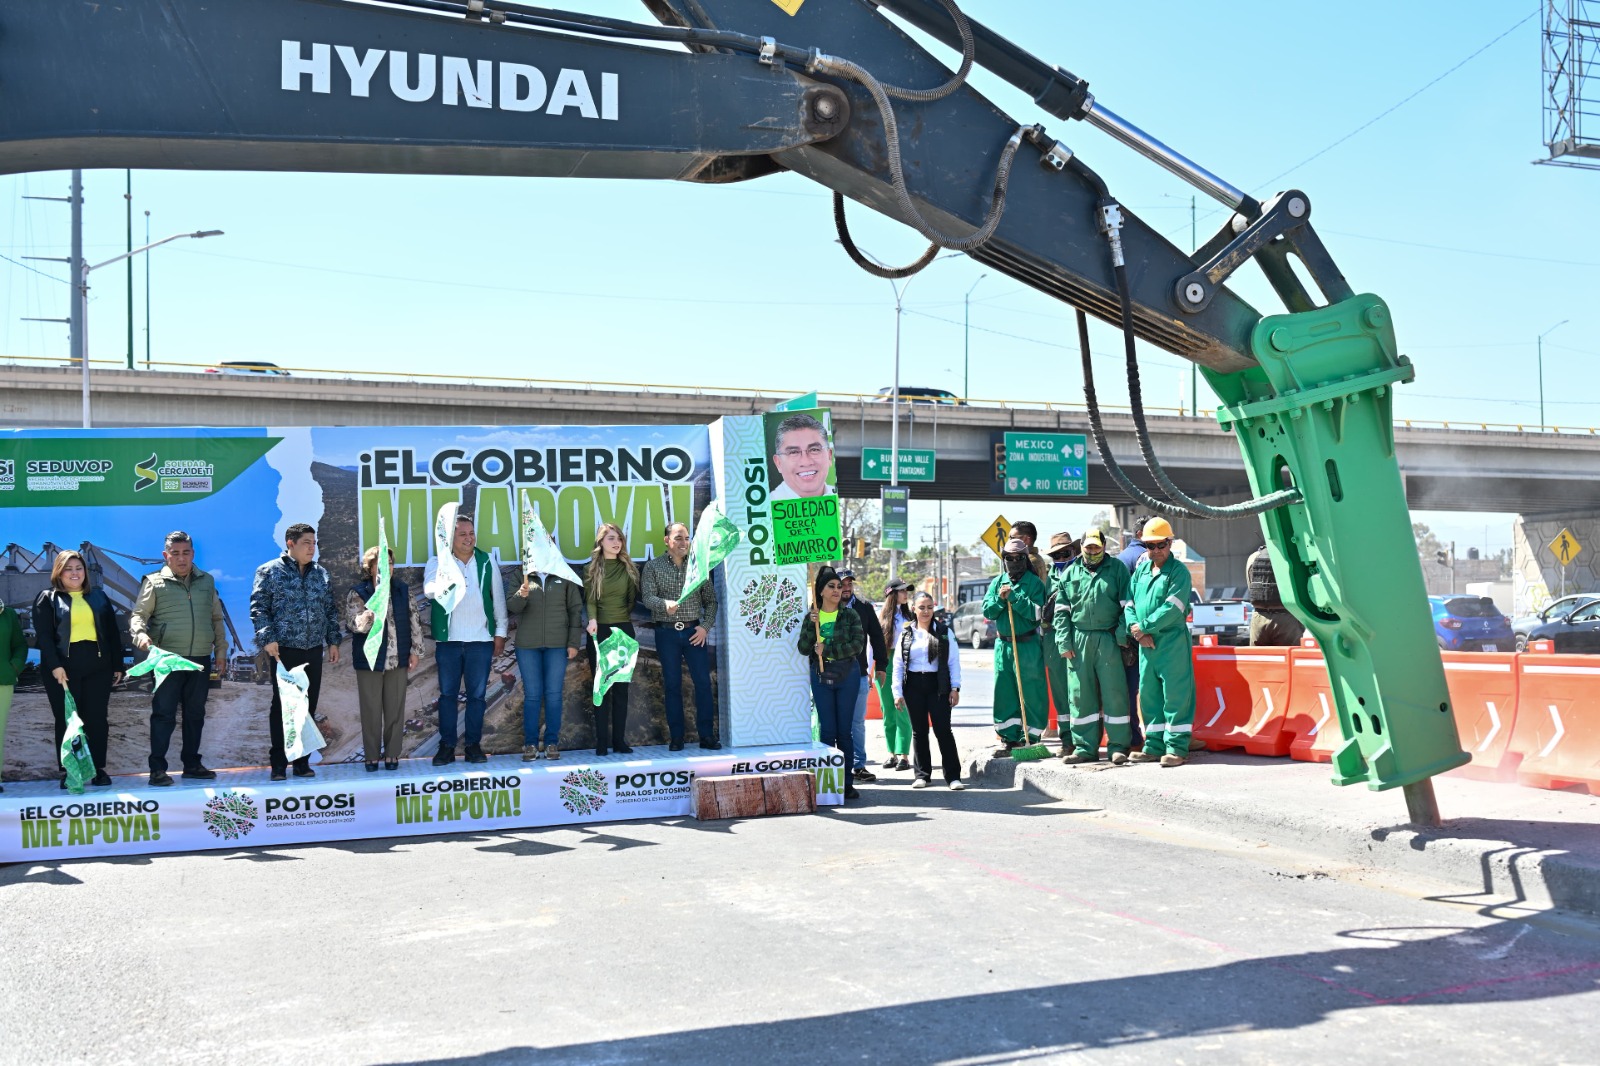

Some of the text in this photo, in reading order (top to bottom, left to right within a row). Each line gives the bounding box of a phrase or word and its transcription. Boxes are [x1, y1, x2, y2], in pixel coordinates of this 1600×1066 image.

[281, 39, 619, 121] HYUNDAI
[1015, 440, 1054, 449] MEXICO
[880, 453, 930, 464] BULVAR VALLE
[1009, 452, 1060, 463] ZONA INDUSTRIAL
[27, 461, 113, 473] SEDUVOP
[164, 460, 206, 468] SOLEDAD
[432, 446, 692, 485] GOBIERNO
[158, 467, 190, 475] CERCA
[191, 467, 203, 475] DE
[1035, 479, 1084, 491] RIO VERDE
[773, 499, 837, 520] SOLEDAD
[785, 518, 817, 529] CERCA
[777, 536, 838, 557] NAVARRO
[755, 754, 845, 772] GOBIERNO
[422, 775, 522, 794] GOBIERNO
[653, 786, 691, 795] POTOSINO
[49, 799, 159, 819] GOBIERNO
[395, 788, 522, 825] ME APOYA!
[291, 812, 307, 820] LOS
[308, 809, 356, 818] POTOSINOS
[20, 813, 161, 849] ME APOYA!
